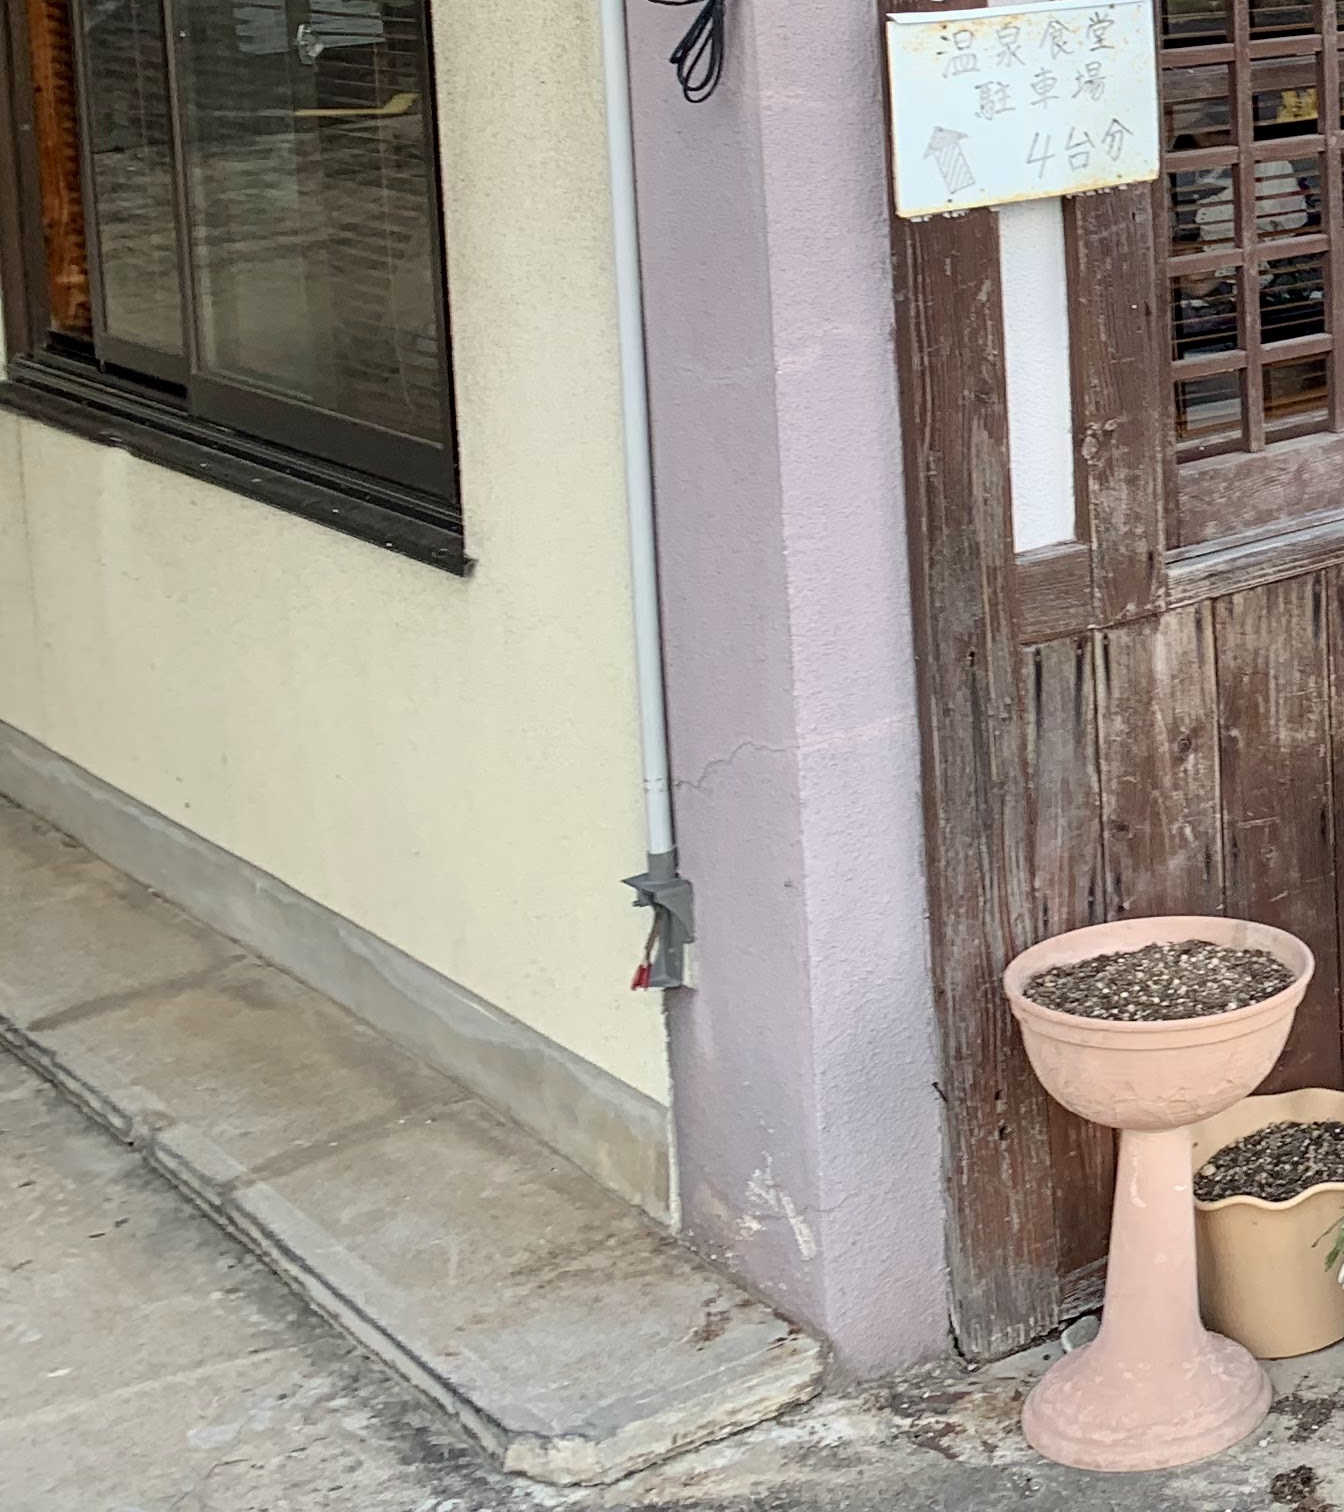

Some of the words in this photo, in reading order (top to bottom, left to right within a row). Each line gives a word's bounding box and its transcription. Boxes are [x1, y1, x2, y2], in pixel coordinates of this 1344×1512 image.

[936, 11, 1116, 79] 温泉食堂
[973, 61, 1107, 121] 駐車場
[1026, 117, 1135, 179] 4台分
